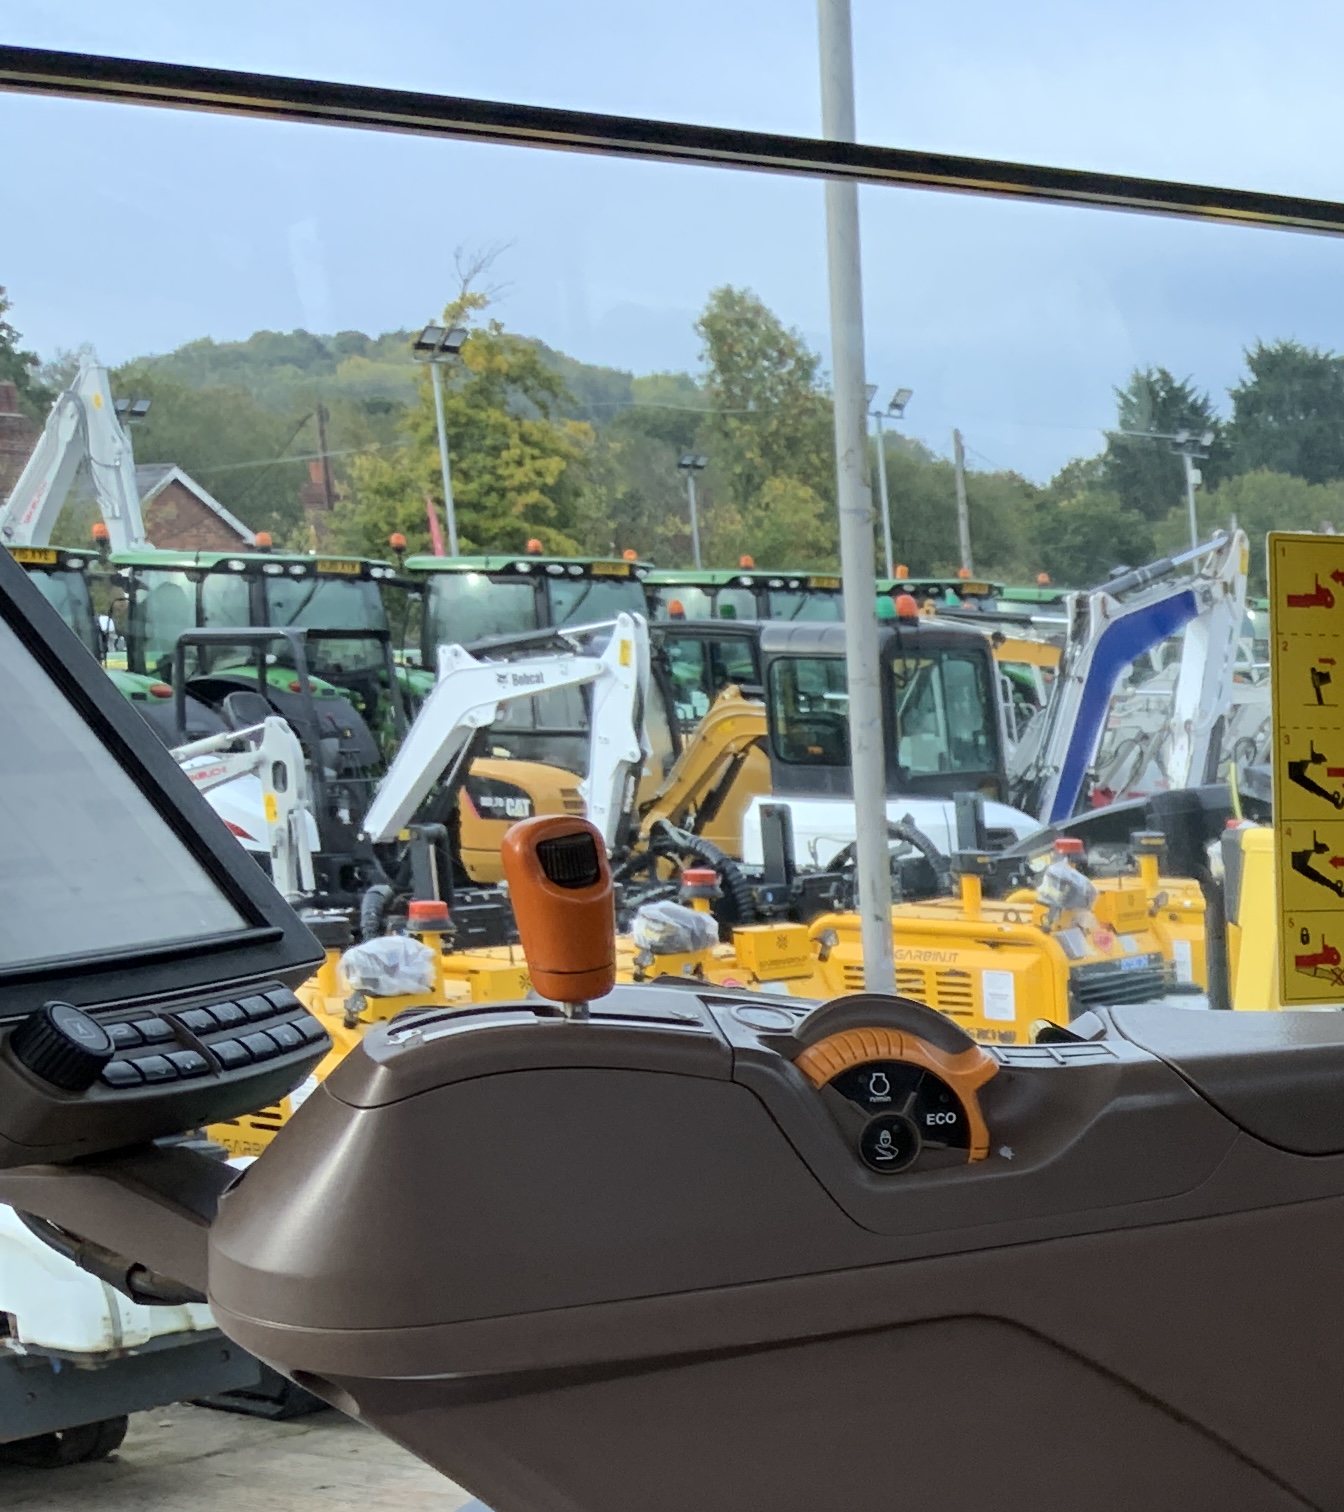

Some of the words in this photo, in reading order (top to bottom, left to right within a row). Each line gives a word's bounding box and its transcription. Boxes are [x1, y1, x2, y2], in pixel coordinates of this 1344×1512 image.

[1281, 547, 1286, 557] 1
[1282, 640, 1289, 652] 2
[511, 671, 545, 686] Bobcat
[1284, 734, 1291, 745] 3
[505, 797, 531, 817] CAT
[1285, 827, 1292, 838] 4
[1288, 917, 1295, 929] 5
[926, 1112, 957, 1126] ECO
